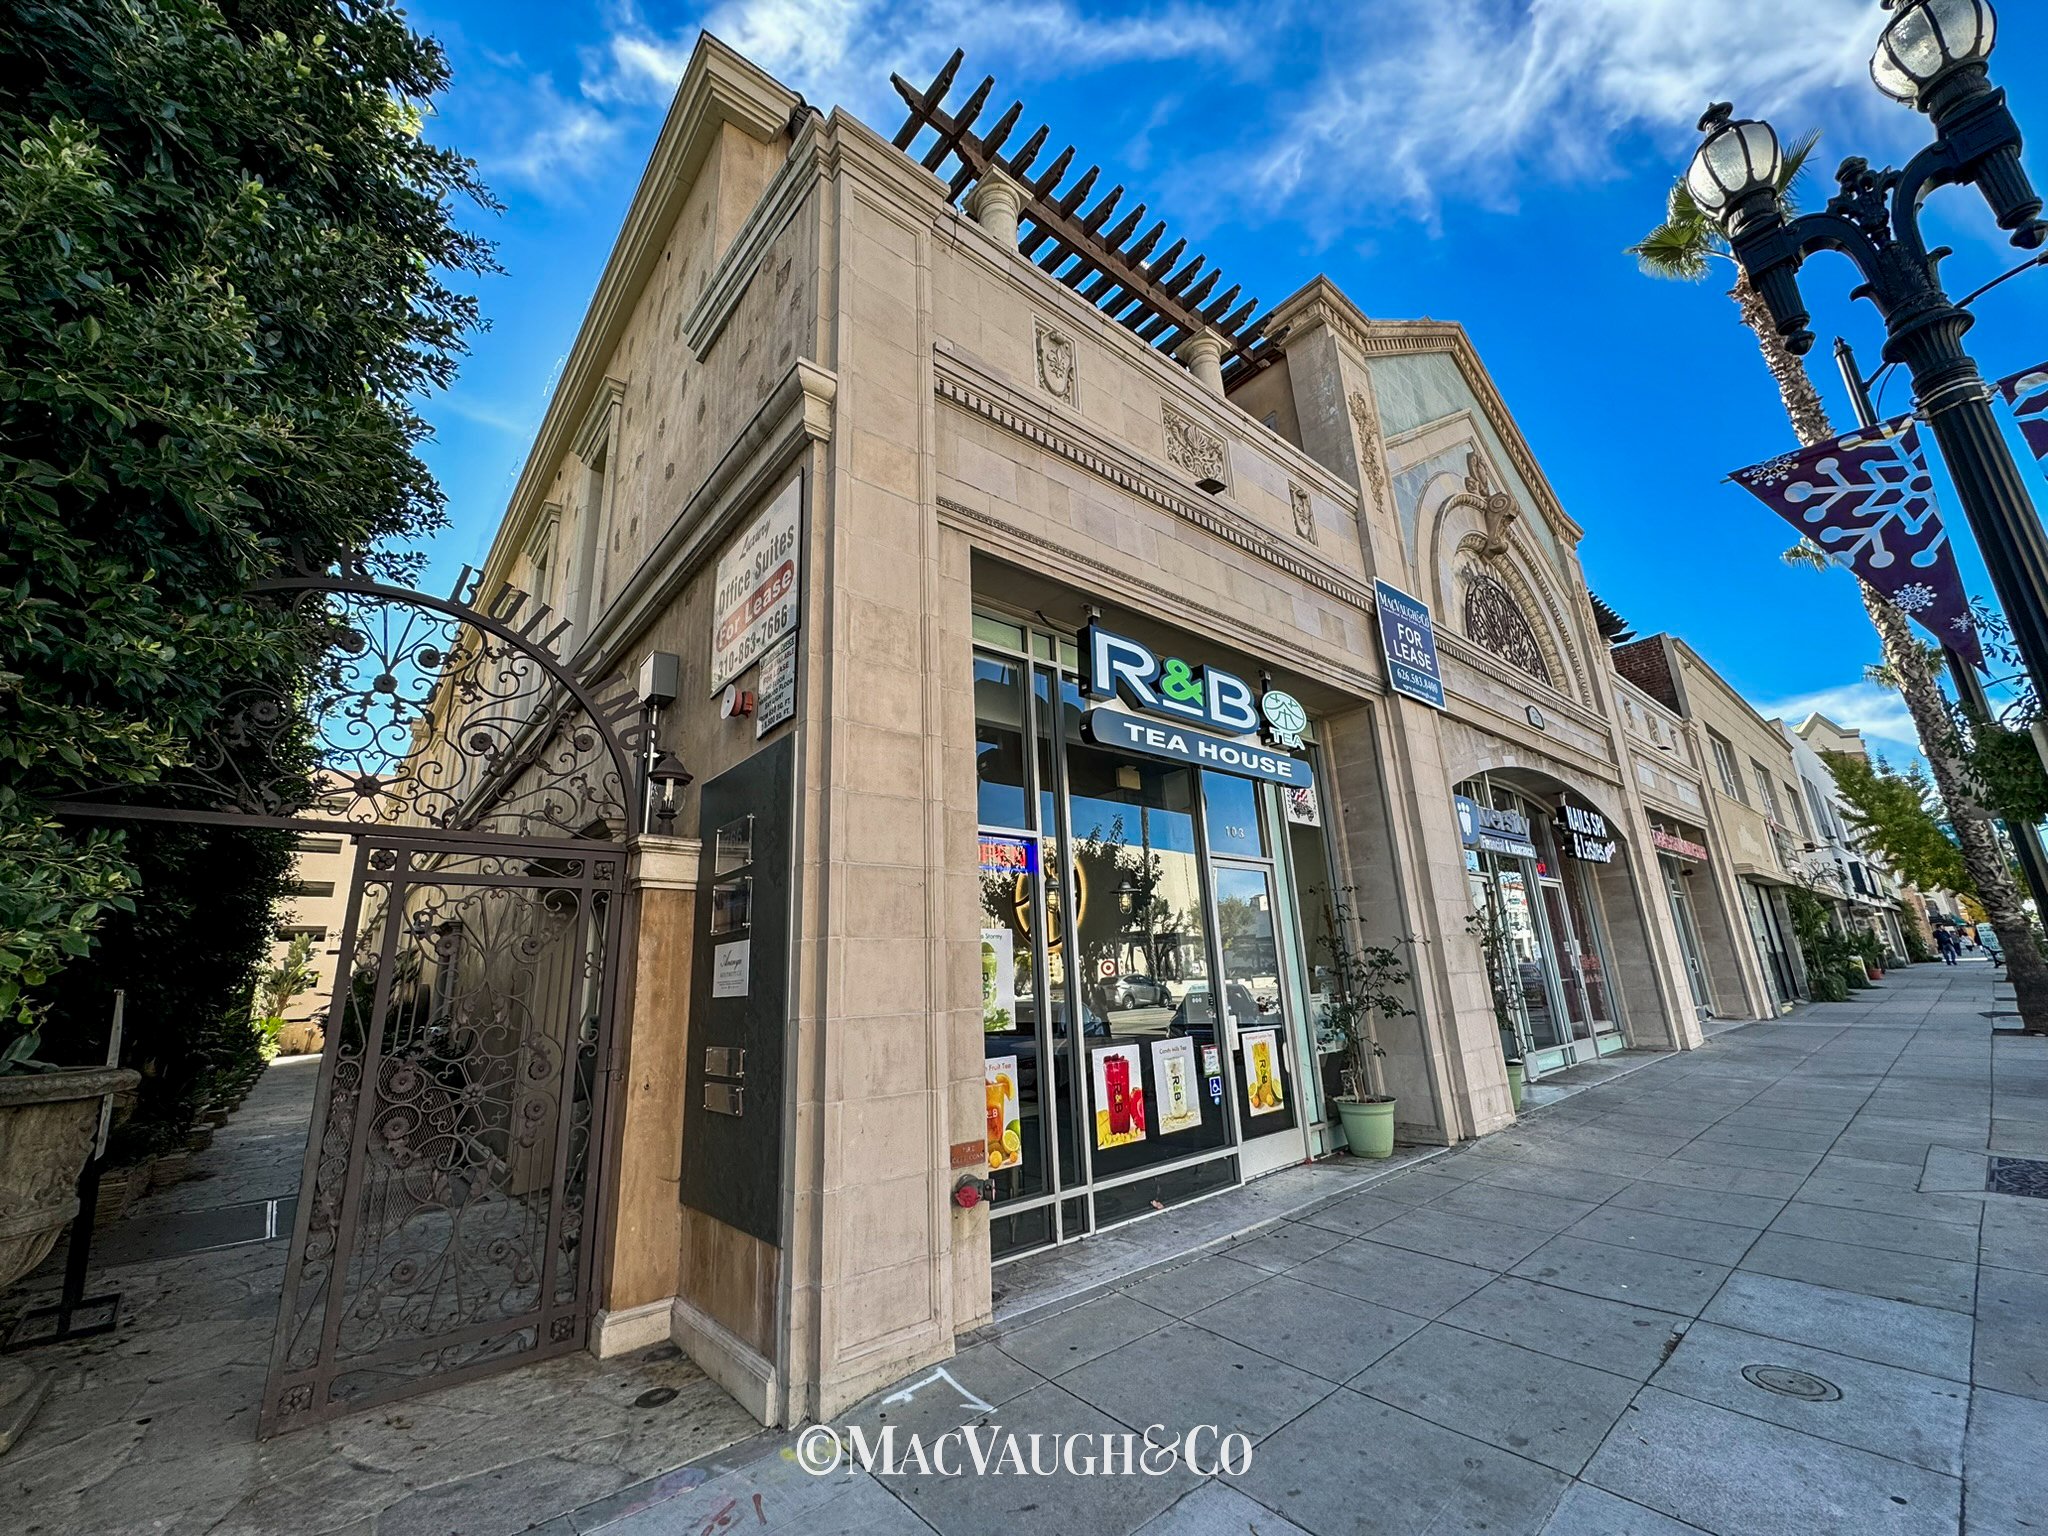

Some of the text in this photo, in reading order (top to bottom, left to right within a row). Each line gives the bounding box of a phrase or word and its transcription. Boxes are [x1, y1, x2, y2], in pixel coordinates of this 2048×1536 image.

[739, 518, 771, 561] Luxury
[718, 524, 794, 616] Office Suites
[718, 567, 793, 648] For Lease
[447, 563, 661, 751] BUILDING
[717, 603, 788, 682] 310-863-7666
[1393, 639, 1433, 671] LEASE
[1397, 622, 1423, 649] FOR
[1095, 631, 1256, 729] R&B
[1123, 722, 1292, 778] TEA HOUSE
[1269, 727, 1305, 751] TEA
[1565, 805, 1607, 838] NAILS SPA
[978, 844, 1026, 867] PEN
